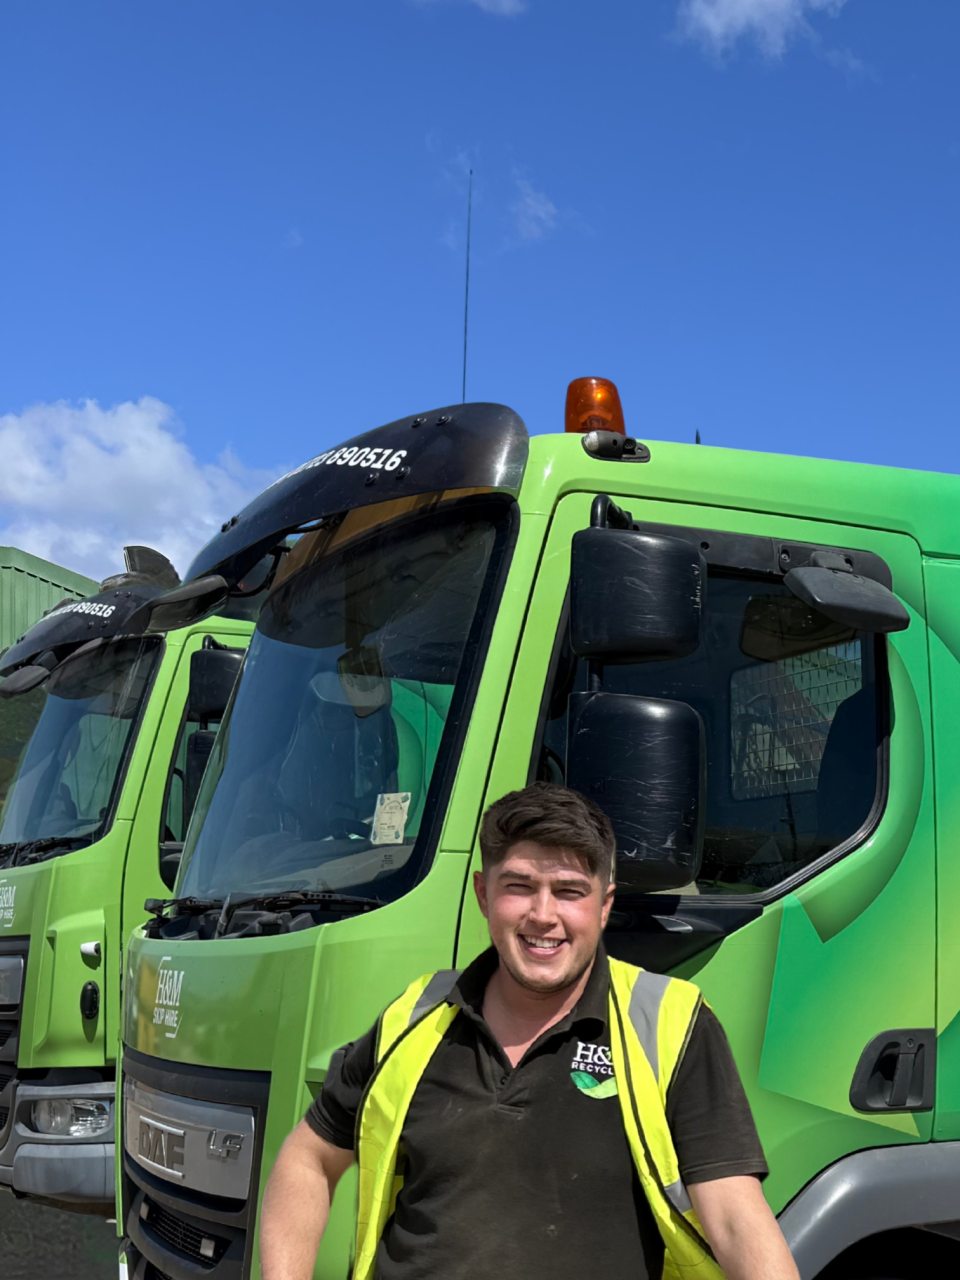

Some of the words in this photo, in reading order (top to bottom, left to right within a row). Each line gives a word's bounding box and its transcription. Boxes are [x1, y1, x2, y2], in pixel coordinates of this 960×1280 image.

[326, 446, 407, 471] 890516
[155, 969, 185, 1007] H&M
[573, 1041, 614, 1066] H&
[571, 1061, 614, 1075] RECYCL
[139, 1121, 185, 1171] DAF
[207, 1129, 245, 1158] LF
